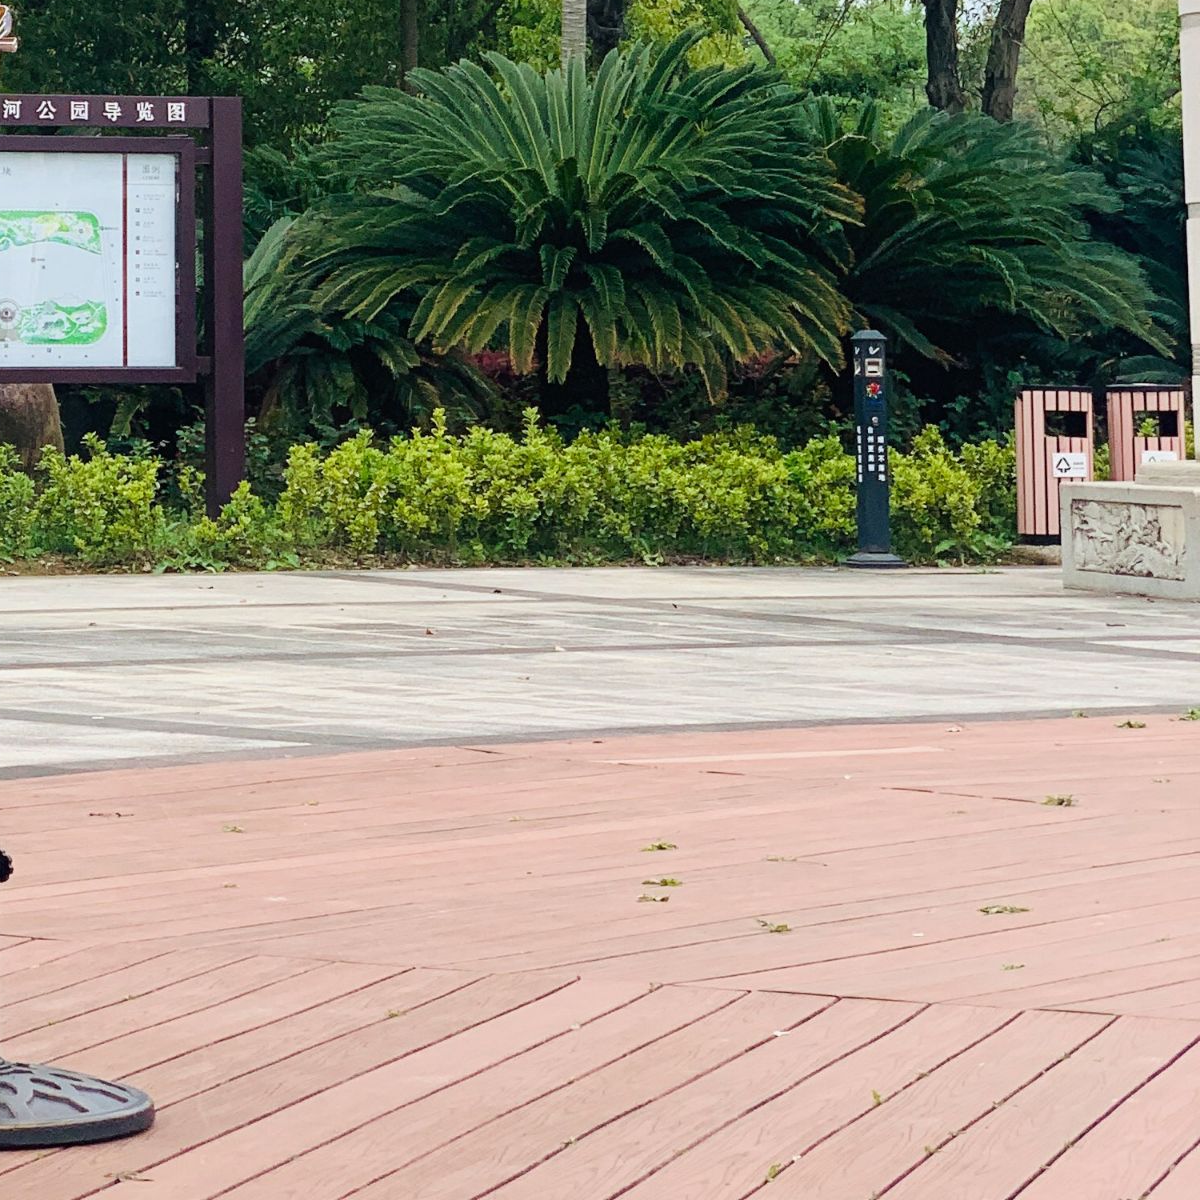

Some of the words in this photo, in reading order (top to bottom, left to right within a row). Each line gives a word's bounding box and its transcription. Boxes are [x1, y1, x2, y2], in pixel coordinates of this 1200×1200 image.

[2, 99, 186, 122] 河公园导览图
